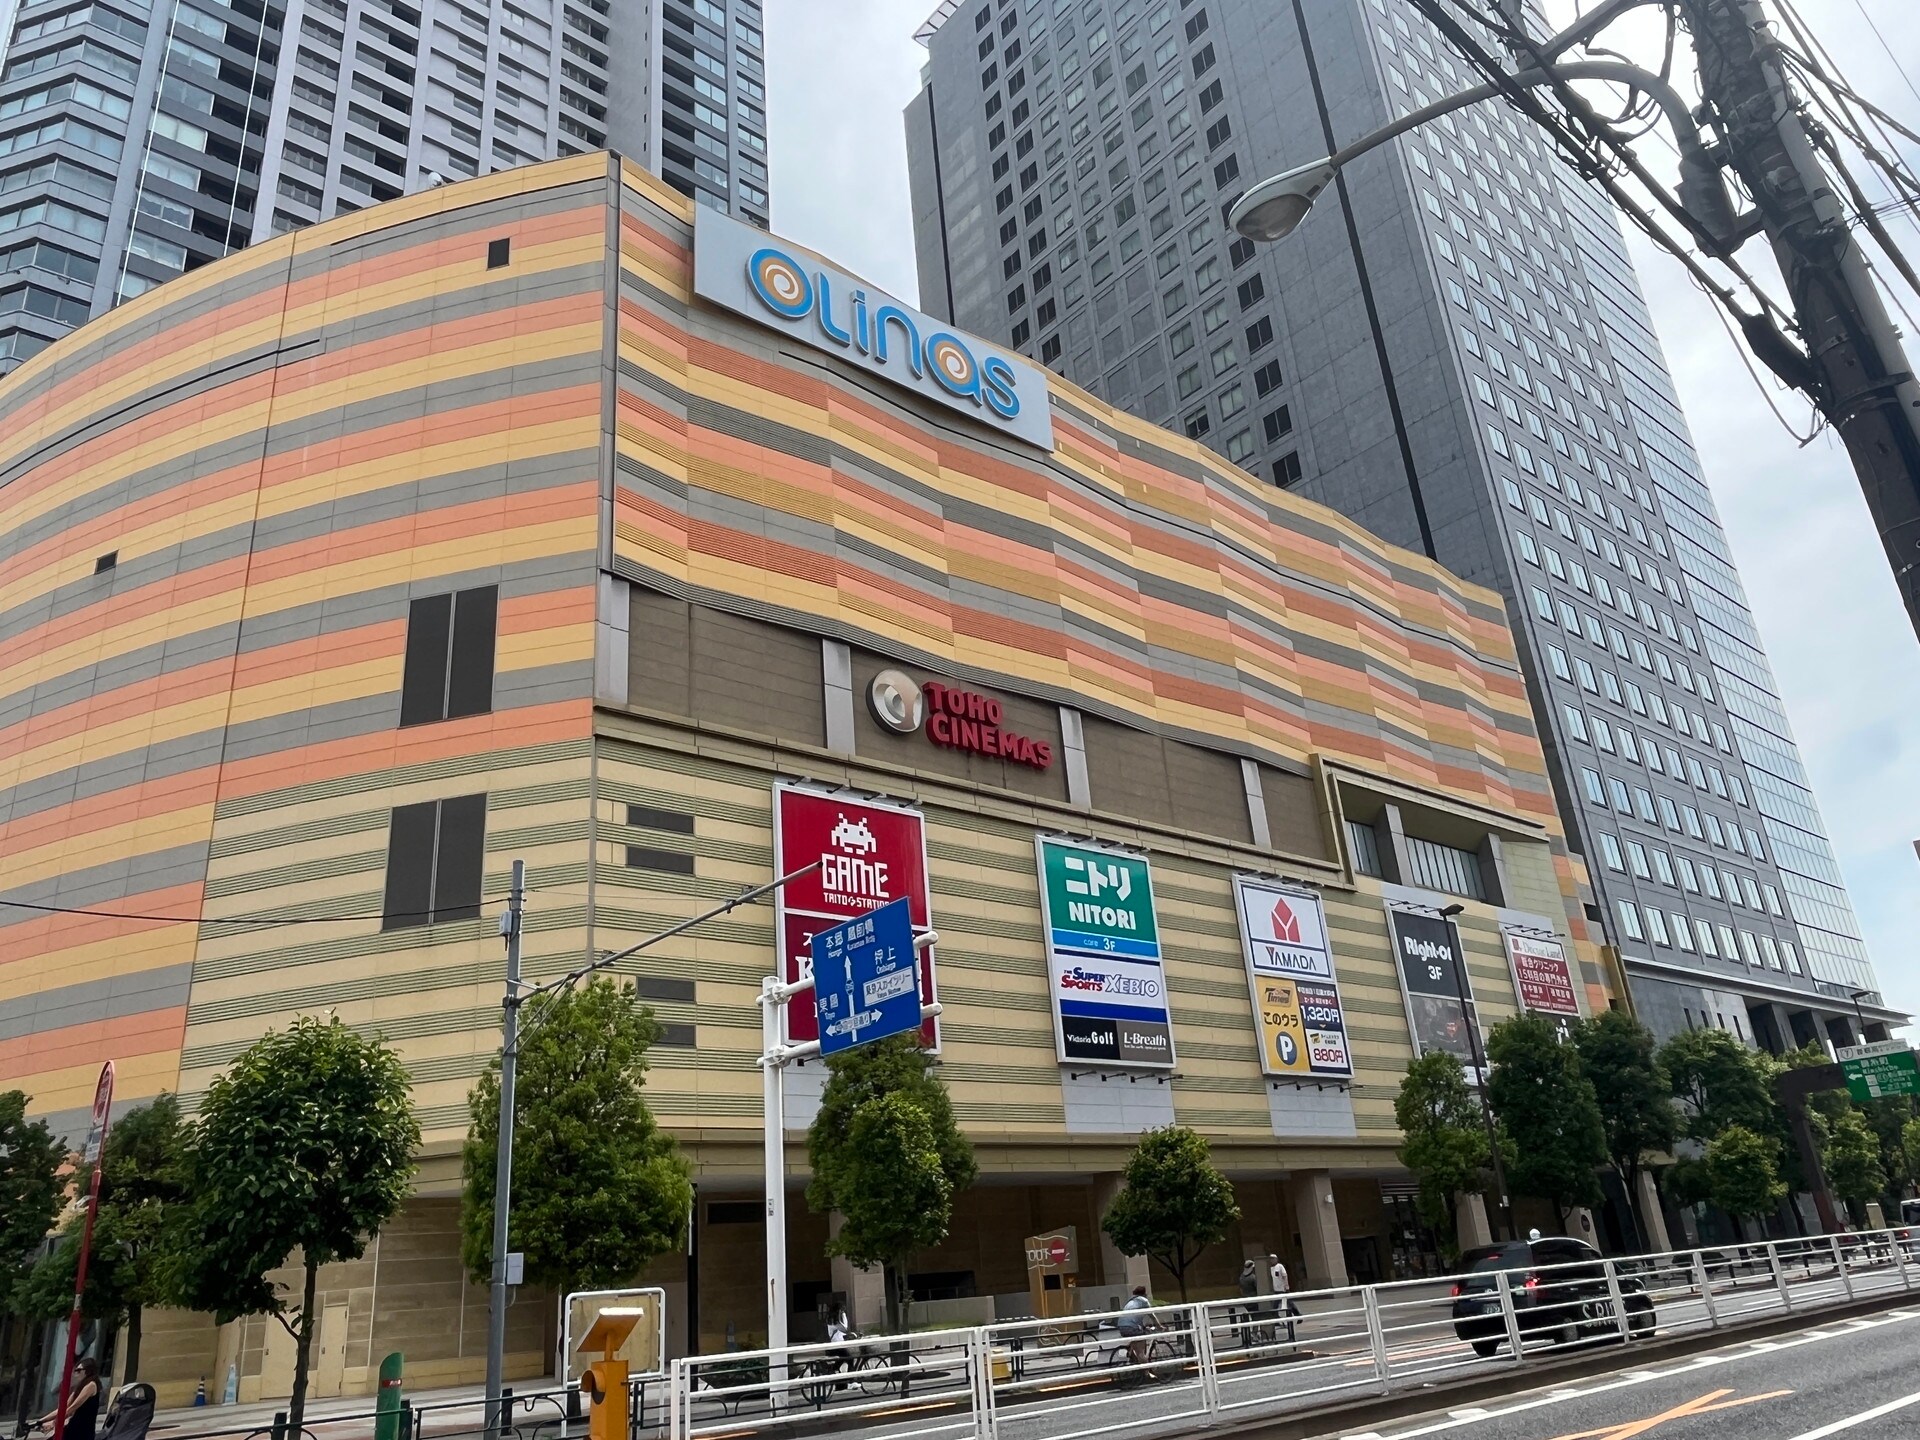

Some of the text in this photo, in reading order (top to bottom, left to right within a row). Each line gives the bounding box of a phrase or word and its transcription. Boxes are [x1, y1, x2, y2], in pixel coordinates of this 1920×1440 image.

[921, 681, 1003, 726] TOHO
[926, 711, 1055, 769] CINEMAS
[822, 853, 889, 898] GAME
[1064, 856, 1132, 902] ニトリ
[823, 892, 848, 906] TAITO
[1068, 901, 1137, 931] NITORI
[1103, 937, 1116, 951] 3F
[1265, 946, 1317, 971] YAMADA
[1072, 967, 1106, 983] SUPER
[1428, 965, 1443, 980] 3F
[1061, 974, 1103, 992] SPORTS
[1105, 974, 1160, 998] XEBIO
[1263, 1011, 1299, 1028] このウラ
[1300, 1005, 1340, 1024] 1,320円
[1091, 1031, 1114, 1045] Golf
[1279, 1035, 1294, 1061] P
[1313, 1047, 1344, 1064] 880円
